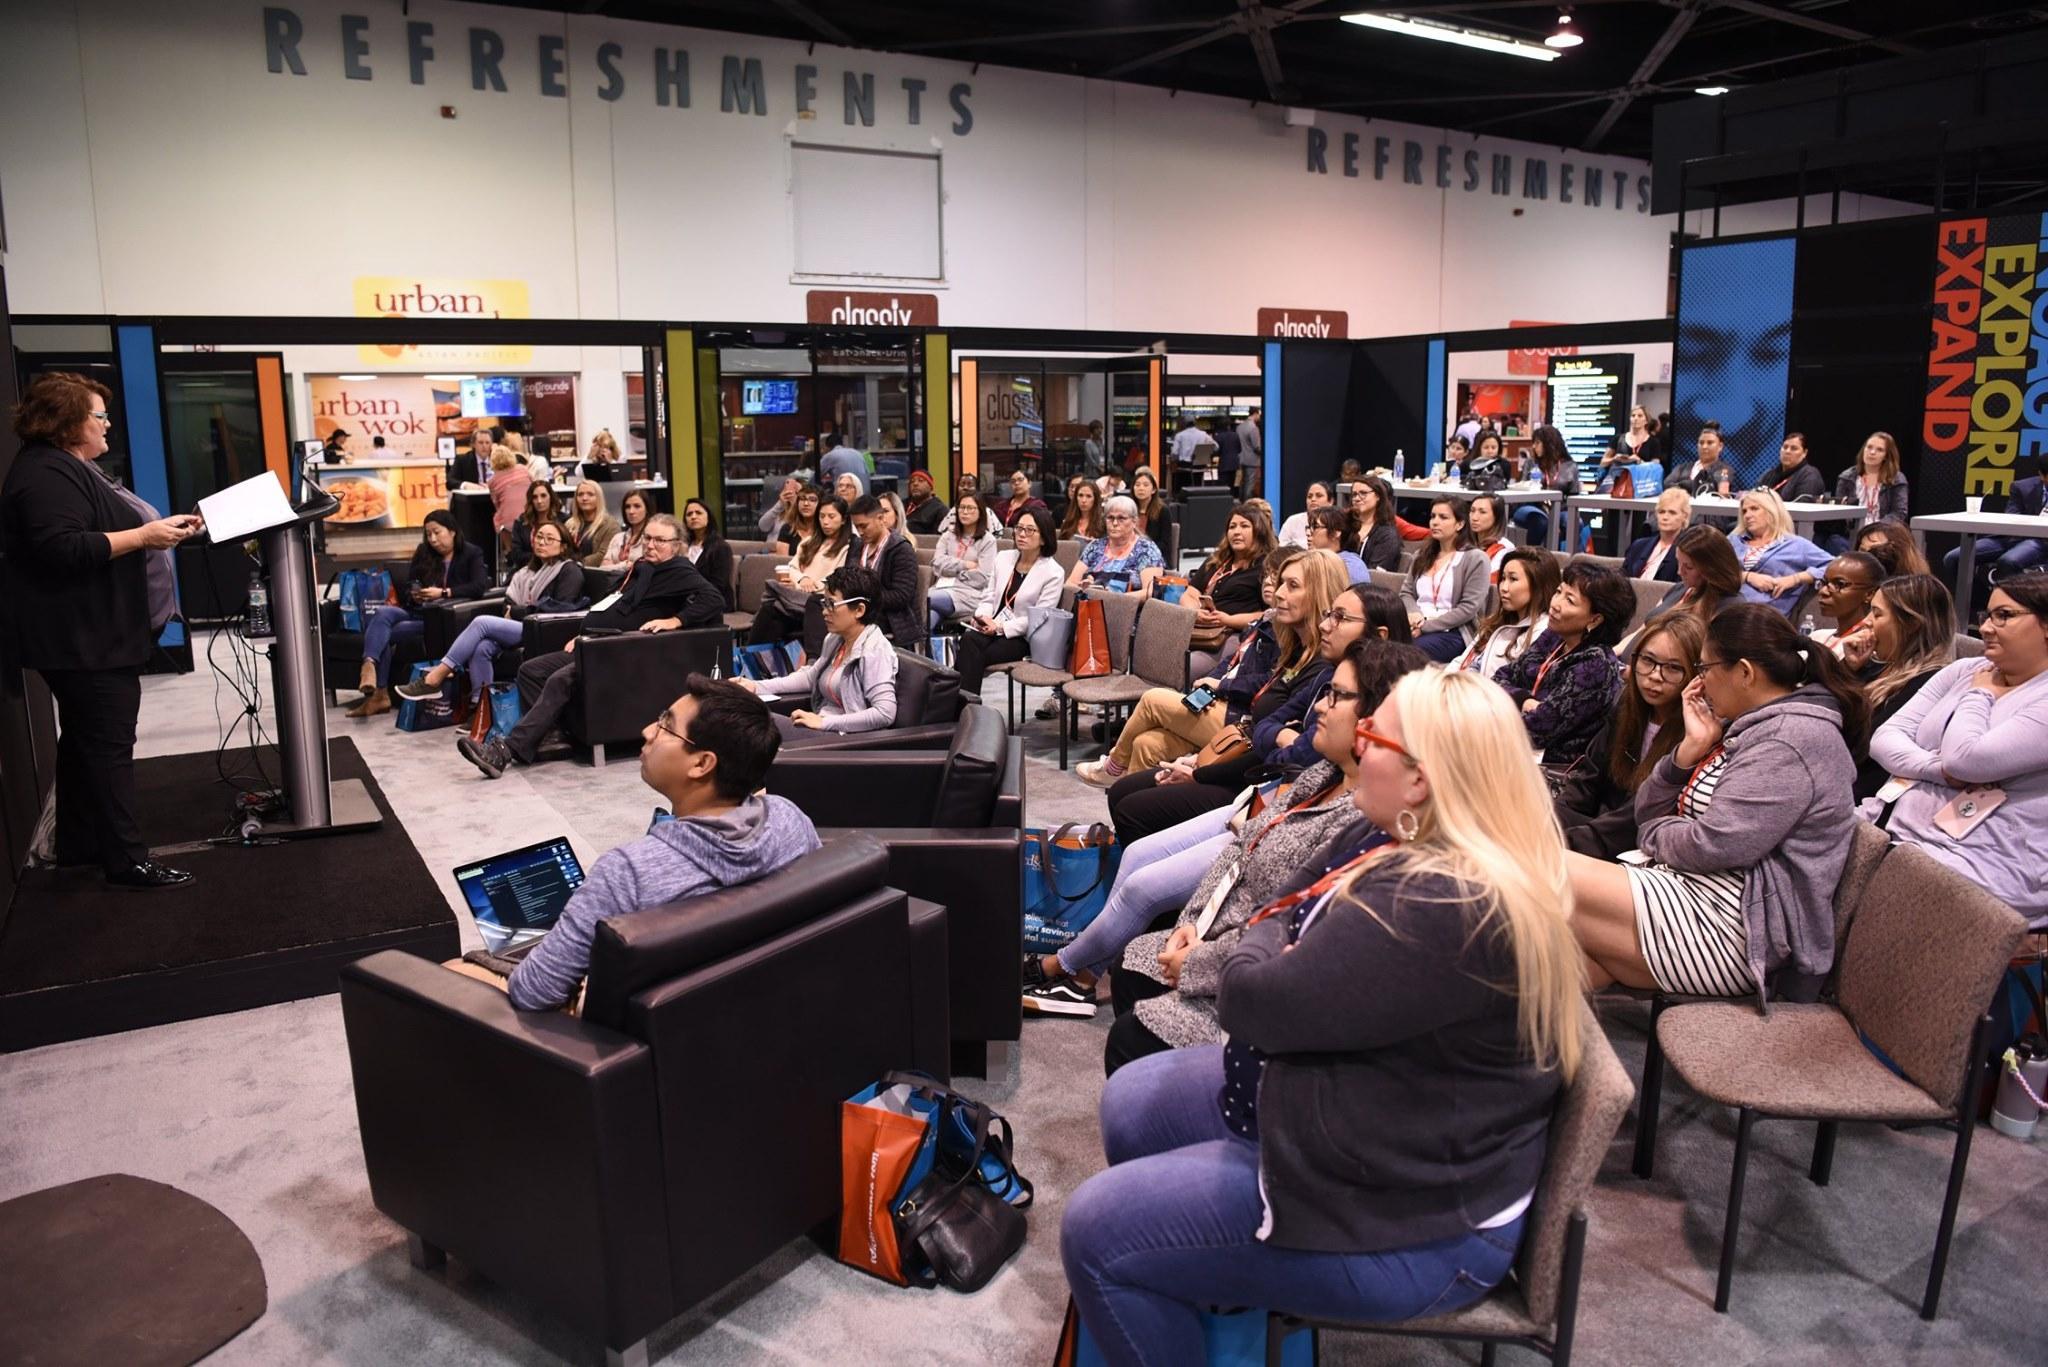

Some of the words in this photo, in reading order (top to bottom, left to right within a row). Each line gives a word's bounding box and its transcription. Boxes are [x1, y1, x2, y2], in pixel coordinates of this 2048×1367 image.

[263, 6, 974, 136] REFRESHMENTS
[1307, 126, 1651, 213] REFRESHMENTS
[374, 284, 484, 313] urban
[1922, 217, 1988, 452] EXPAND
[1963, 243, 2038, 497] EXPLORE
[359, 411, 427, 436] wok
[1041, 926, 1075, 938] savings
